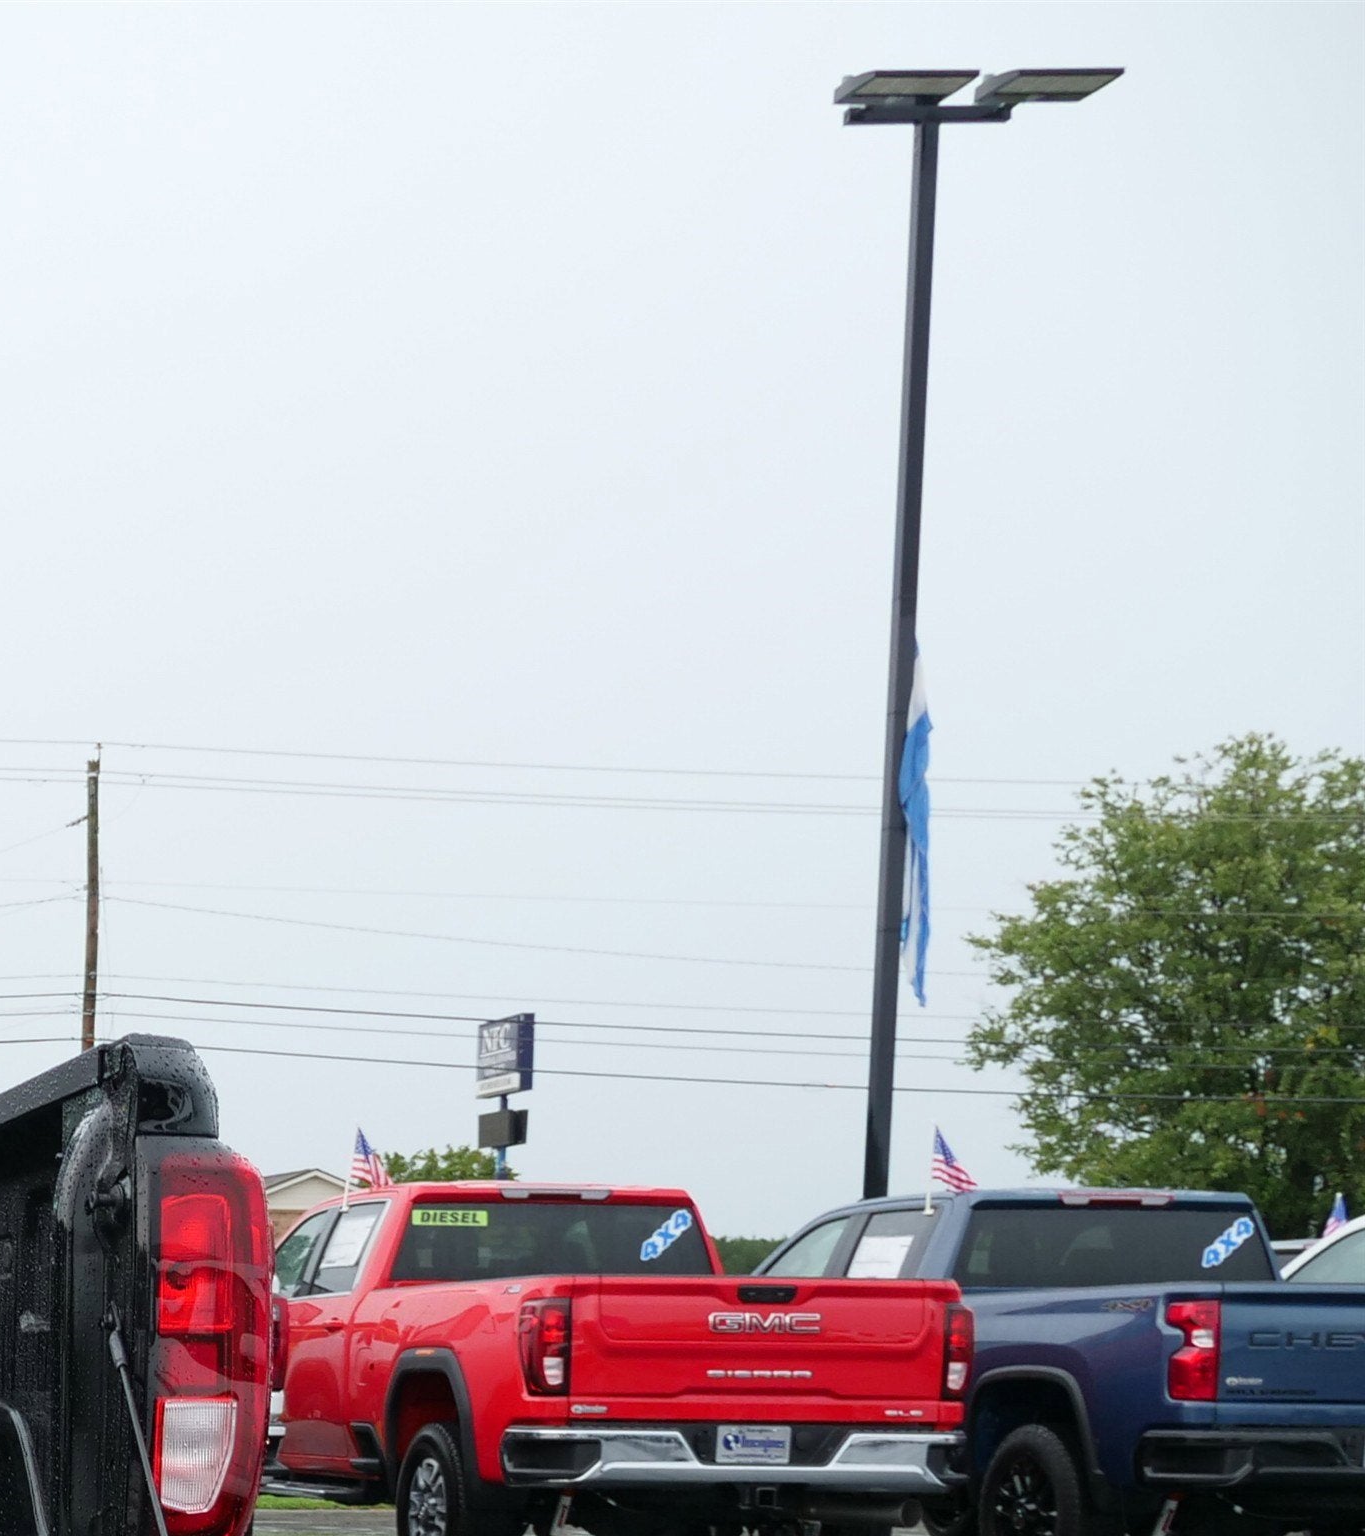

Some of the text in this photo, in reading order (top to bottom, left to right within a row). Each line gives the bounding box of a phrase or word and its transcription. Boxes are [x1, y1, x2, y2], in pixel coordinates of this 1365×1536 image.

[420, 1211, 480, 1224] DIESEL
[642, 1211, 690, 1259] 4X4
[1203, 1218, 1253, 1266] 4X4
[708, 1311, 821, 1334] GMC
[1248, 1331, 1365, 1351] CHE
